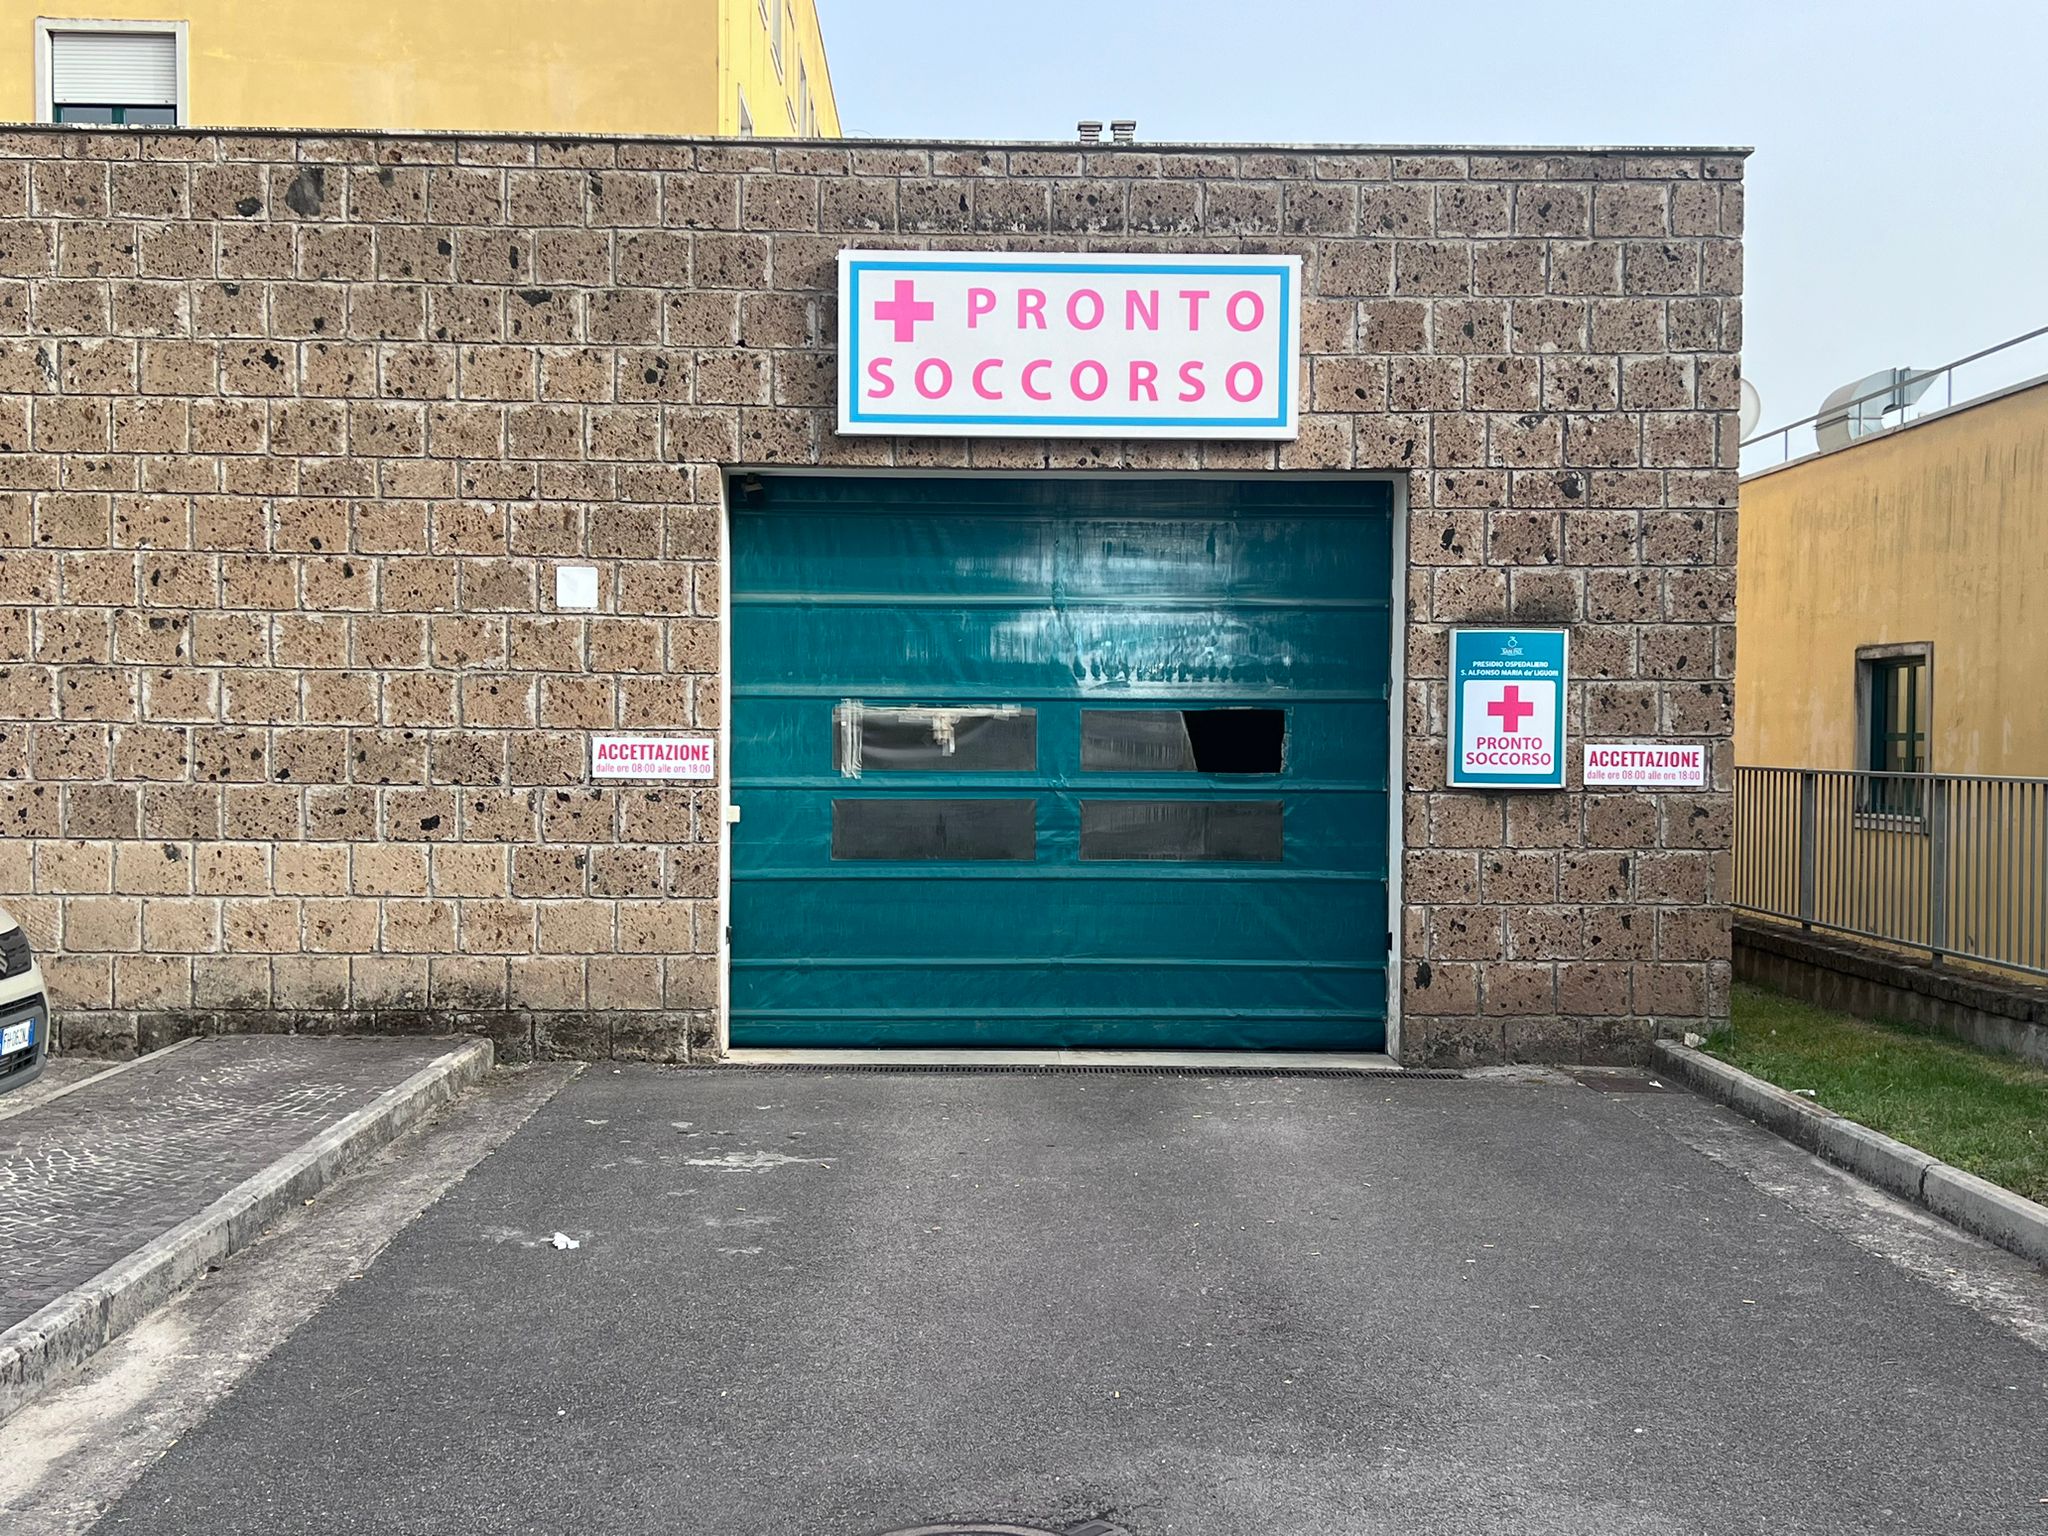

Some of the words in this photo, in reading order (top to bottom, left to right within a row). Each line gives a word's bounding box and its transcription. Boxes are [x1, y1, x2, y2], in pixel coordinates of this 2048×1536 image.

[967, 287, 1265, 332] PRONTO
[866, 356, 1264, 403] SOCCORSO
[1500, 669, 1523, 677] MARIA
[1476, 736, 1543, 750] PRONTO
[597, 743, 710, 761] ACCETTAZIONE
[1465, 752, 1552, 766] SOCCORSO
[1589, 750, 1700, 768] ACCETTAZIONE
[596, 763, 615, 773] dalle
[616, 765, 629, 773] ore
[657, 763, 671, 773] alle
[673, 765, 686, 773] ore
[1587, 770, 1605, 780] dalle
[1607, 772, 1620, 780] ore
[1647, 771, 1662, 780] alle
[1663, 772, 1676, 780] ore
